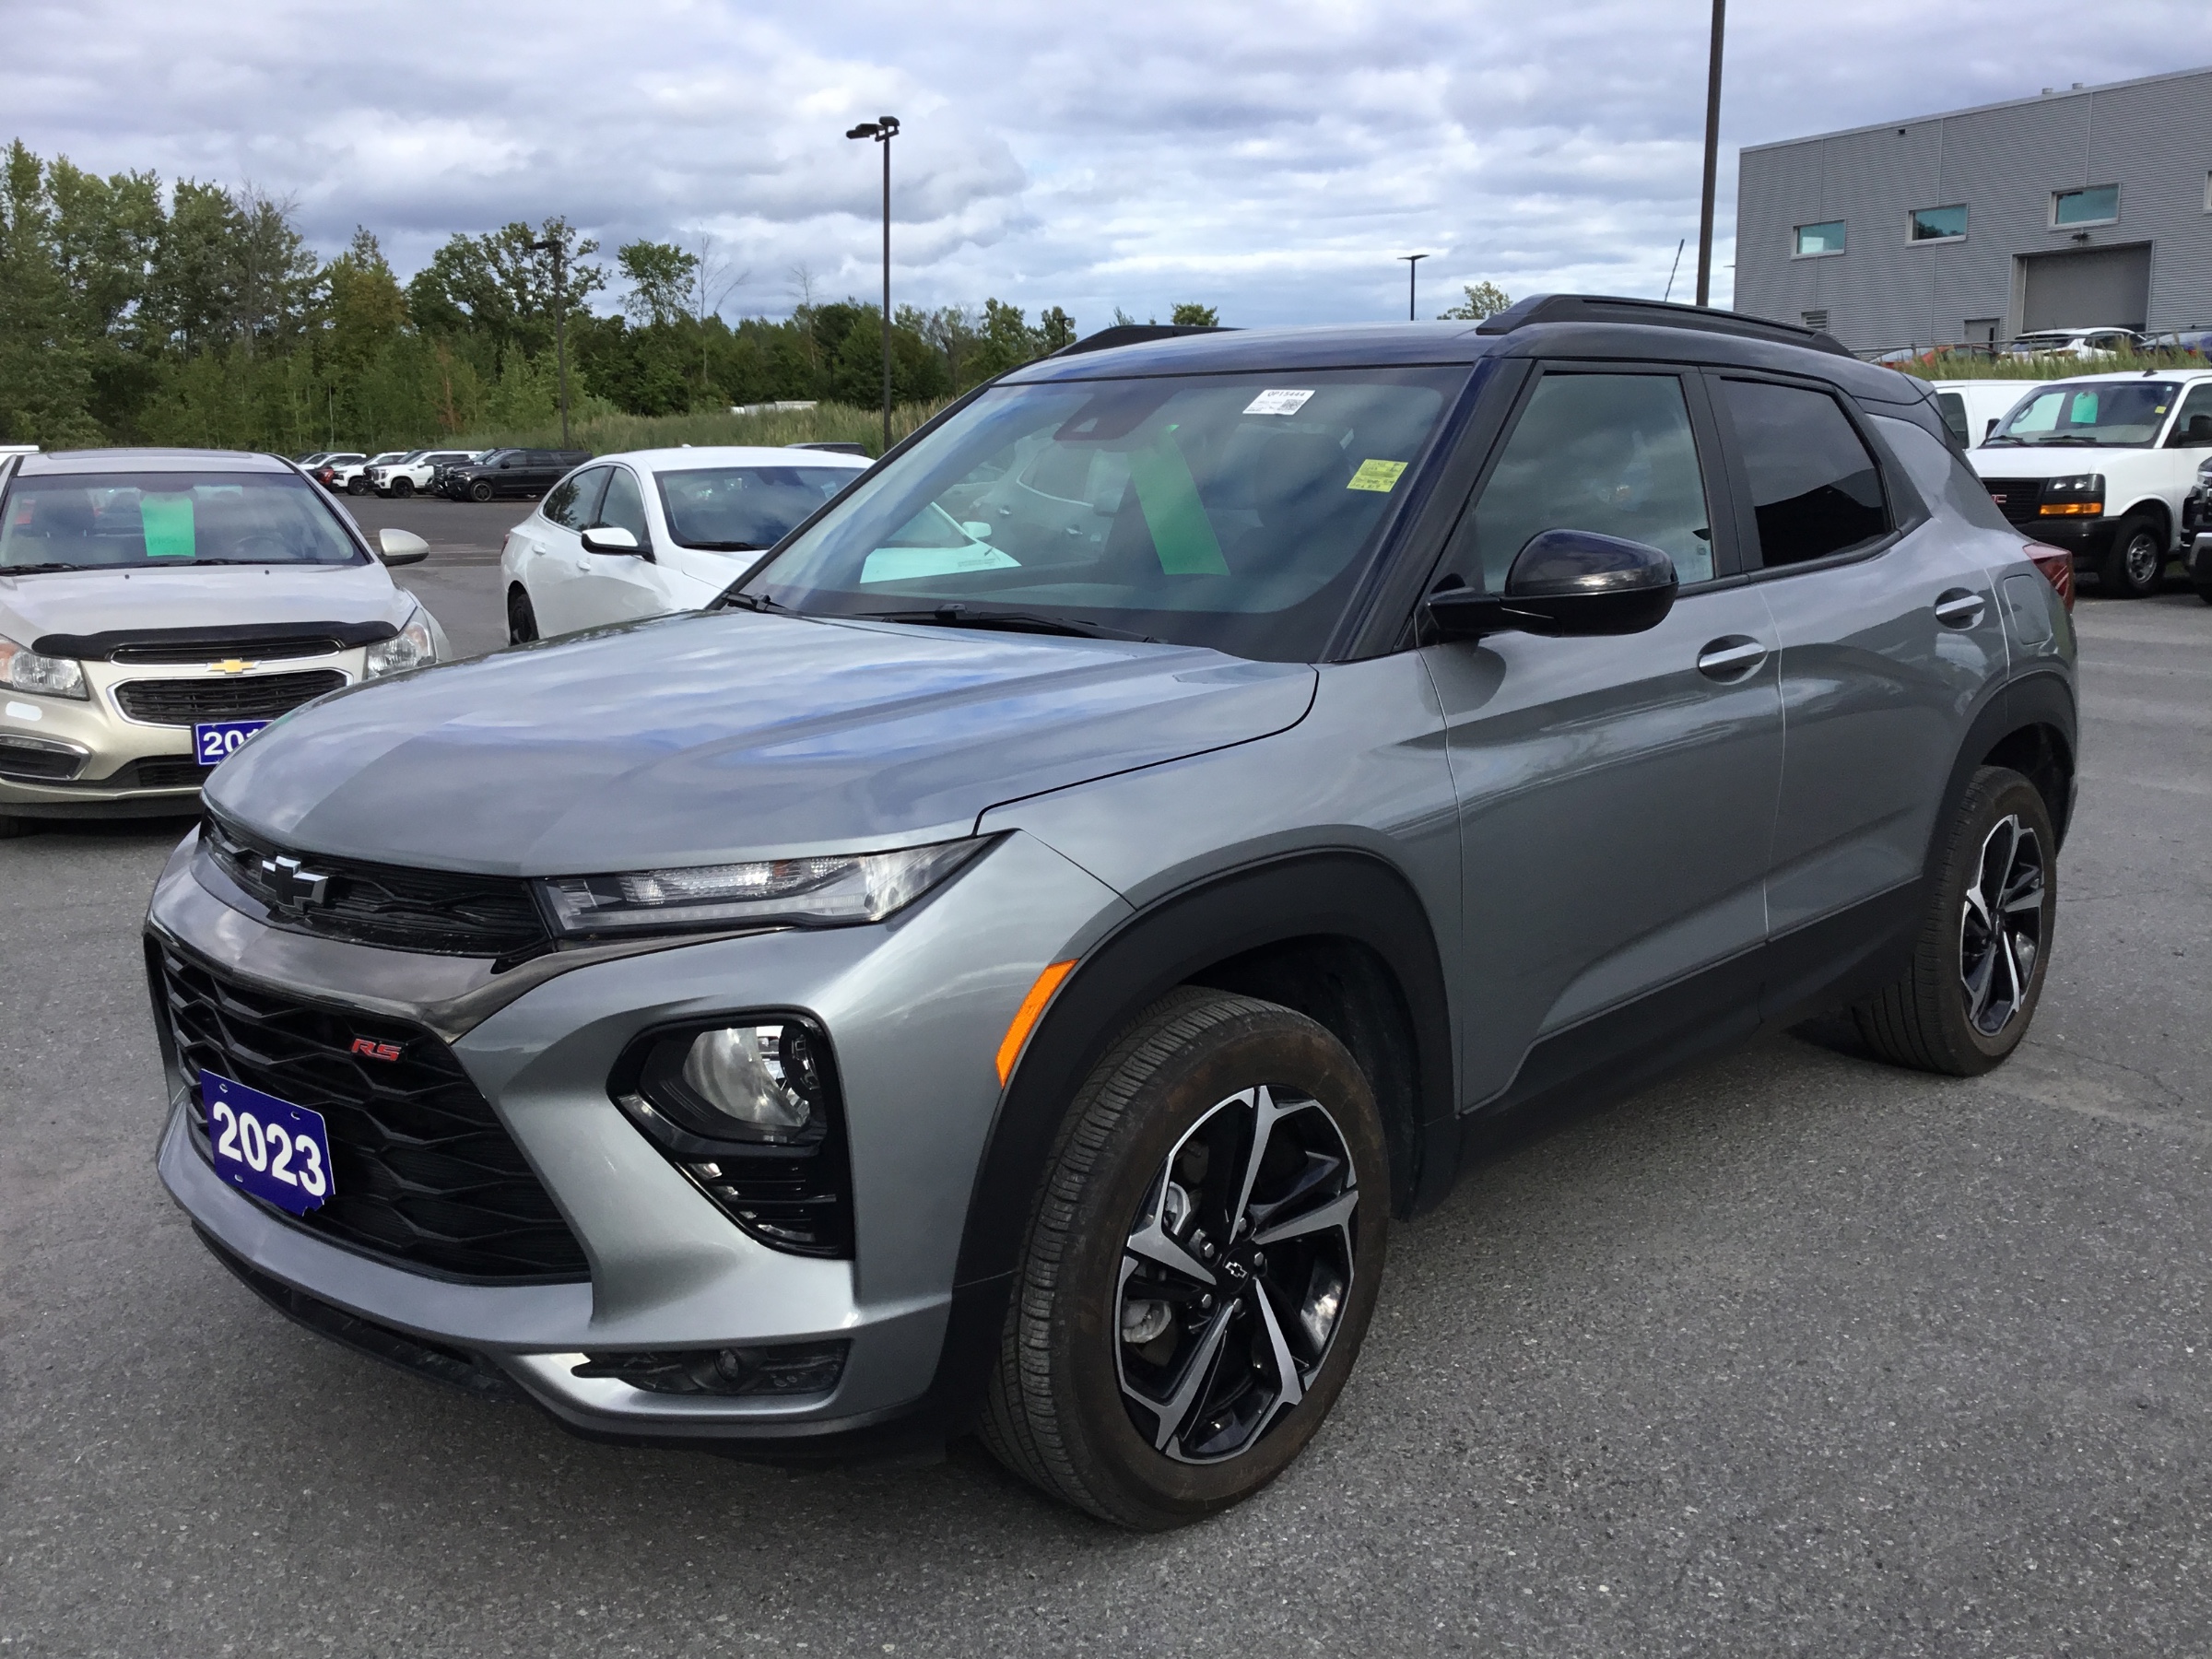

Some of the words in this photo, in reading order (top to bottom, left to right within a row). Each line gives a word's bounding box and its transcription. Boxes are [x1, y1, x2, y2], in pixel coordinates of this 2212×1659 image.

[203, 729, 259, 756] 20
[350, 1038, 402, 1061] RS
[213, 1101, 326, 1196] 2023
